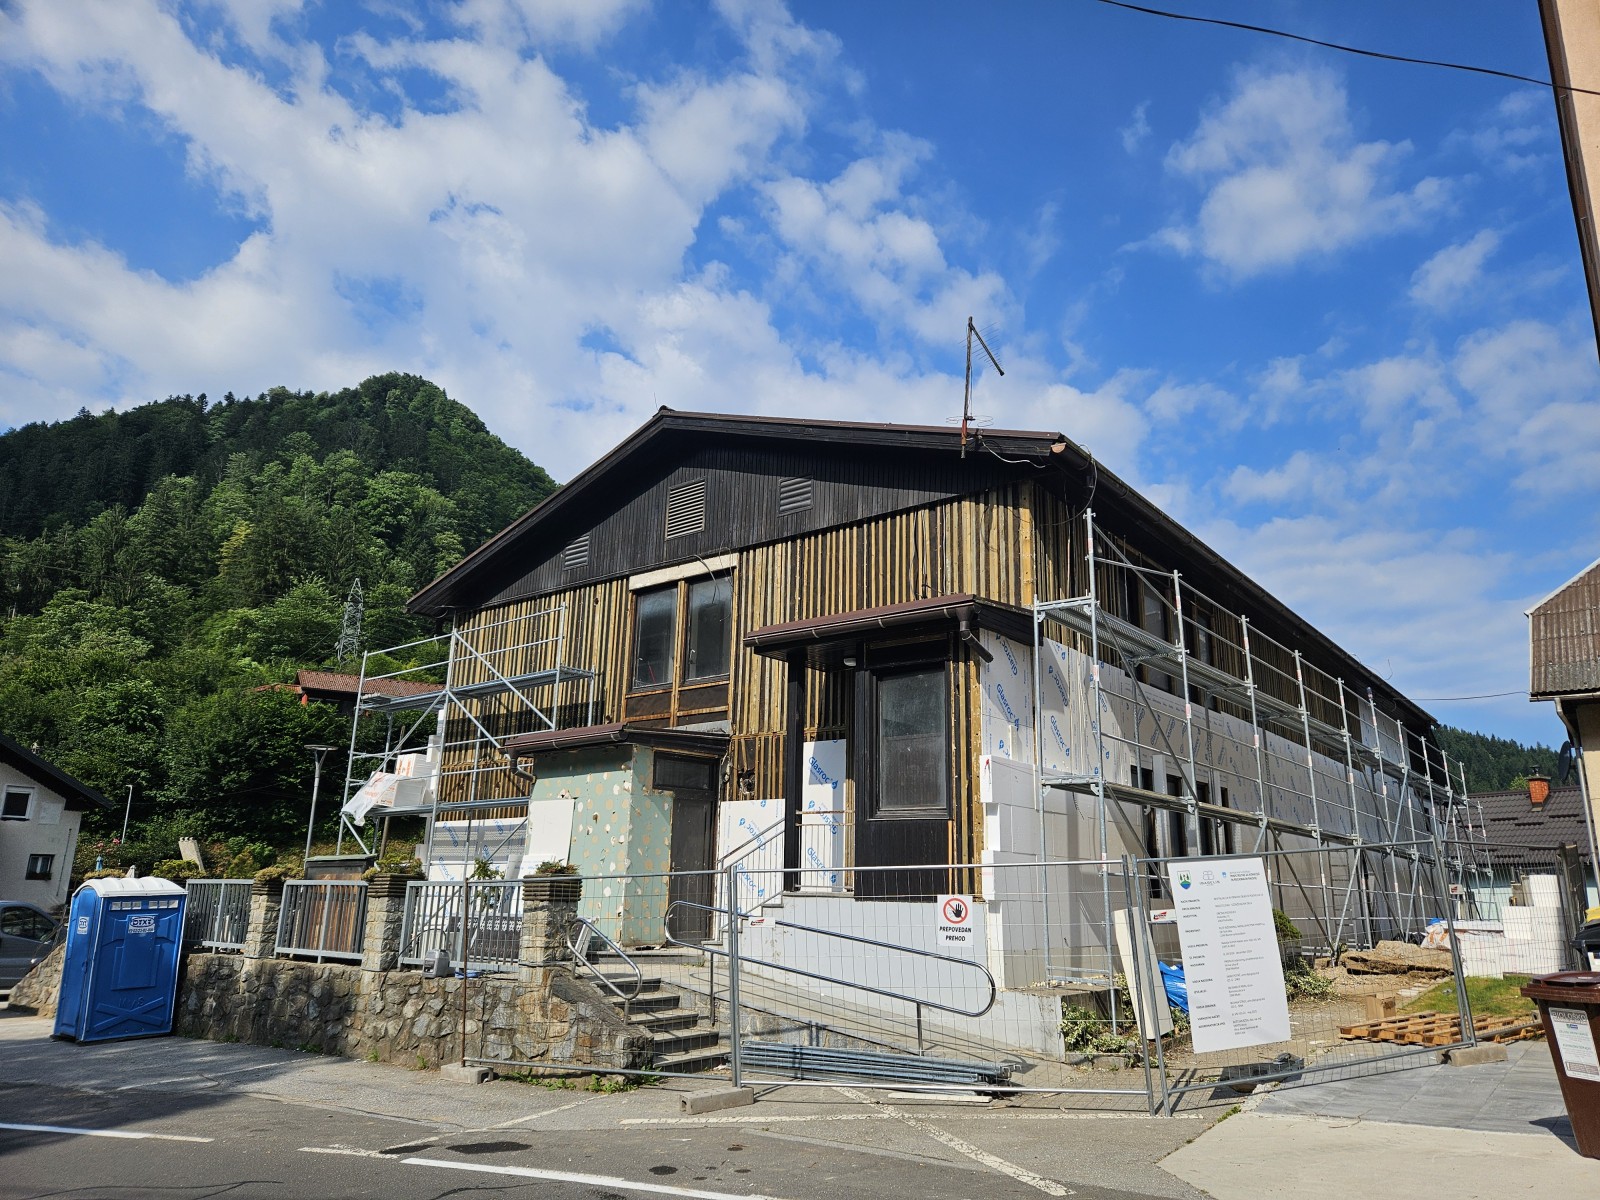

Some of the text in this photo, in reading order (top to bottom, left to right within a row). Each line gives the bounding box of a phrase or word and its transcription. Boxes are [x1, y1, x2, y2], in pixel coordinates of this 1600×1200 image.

[996, 683, 1013, 719] Glasroc
[1050, 715, 1066, 748] Glasroc
[809, 756, 830, 784] Glasroc
